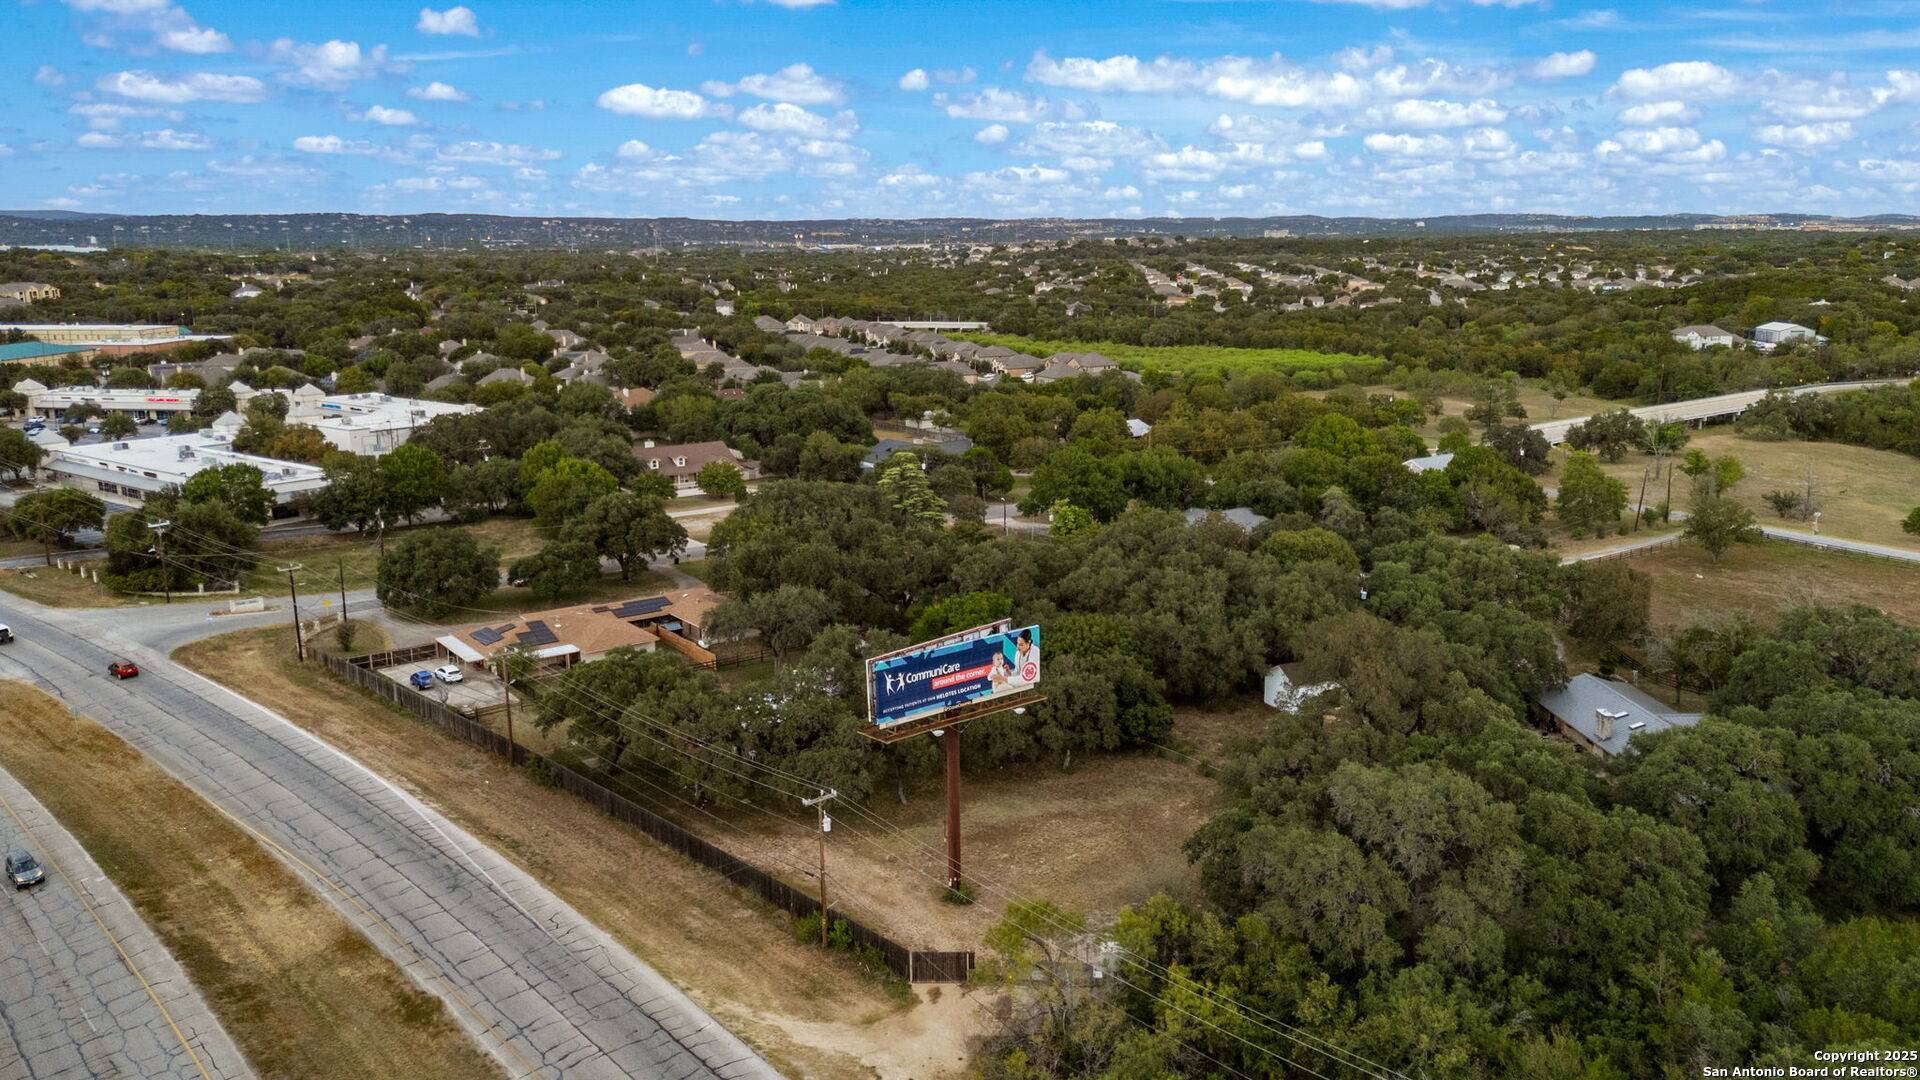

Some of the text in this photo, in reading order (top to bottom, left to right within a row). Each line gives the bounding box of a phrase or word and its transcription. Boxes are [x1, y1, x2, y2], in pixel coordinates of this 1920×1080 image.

[905, 663, 960, 684] CommuniCare
[933, 668, 986, 687] around the corner.
[936, 690, 957, 700] HELOTES
[957, 684, 981, 694] LOCATION
